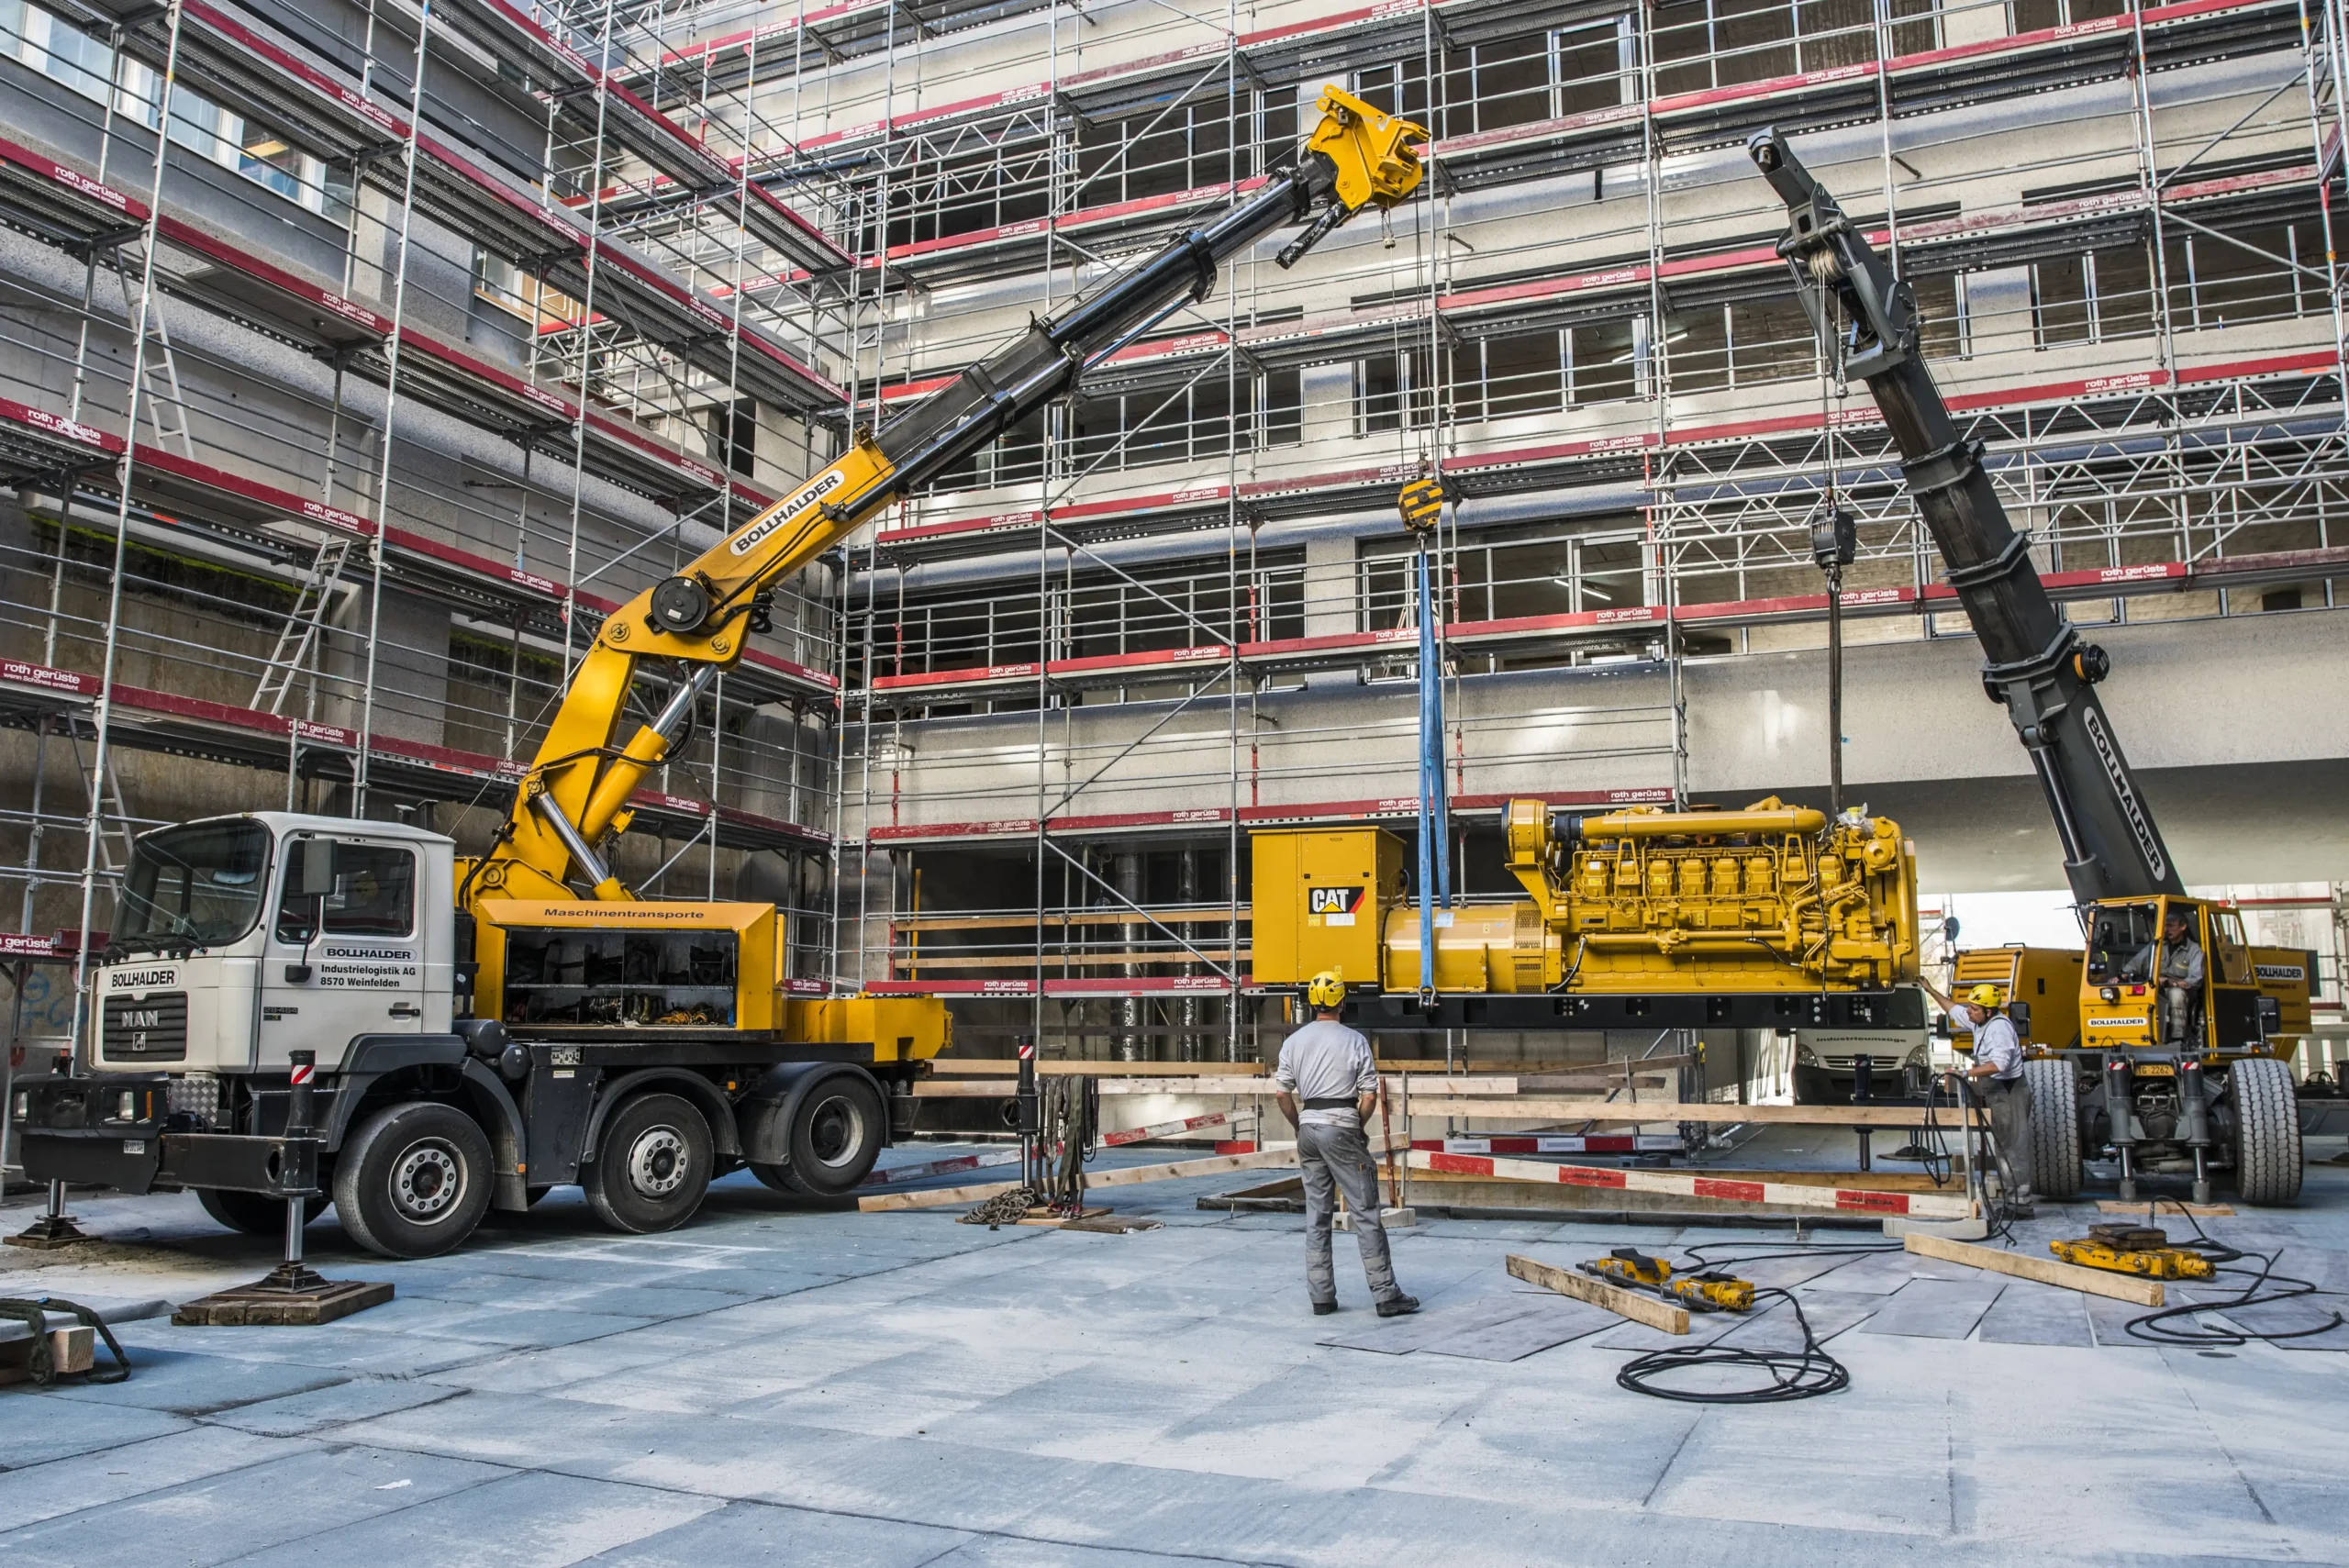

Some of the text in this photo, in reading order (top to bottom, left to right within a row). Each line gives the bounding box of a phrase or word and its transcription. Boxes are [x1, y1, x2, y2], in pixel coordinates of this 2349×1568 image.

[342, 89, 358, 102] roth
[55, 166, 79, 183] roth
[323, 293, 341, 306] roth
[2085, 373, 2149, 388] roth gerüste
[524, 384, 538, 395] roth
[28, 409, 52, 423] roth
[305, 502, 323, 513] roth
[735, 475, 839, 551] BOLLHALDER
[511, 570, 526, 579] roth
[2101, 569, 2122, 577] roth
[1861, 590, 1898, 601] gerüste
[5, 662, 81, 684] roth gerüste
[288, 720, 307, 730] rth
[310, 724, 344, 737] gerüste
[1631, 790, 1666, 799] gerüste
[2087, 715, 2161, 873] BOLLHALDER
[1312, 888, 1349, 913] CAT
[544, 908, 705, 919] Maschinentransporte
[5, 938, 52, 949] gerüste
[0, 947, 25, 955] chönes
[327, 949, 411, 959] BOLLHALDER
[321, 964, 416, 976] Industrielogistik AG
[111, 970, 175, 987] BOLLHALDER
[320, 977, 400, 987] 8570 Weinfelden
[121, 1011, 159, 1028] MAN
[2152, 1066, 2170, 1074] 2262
